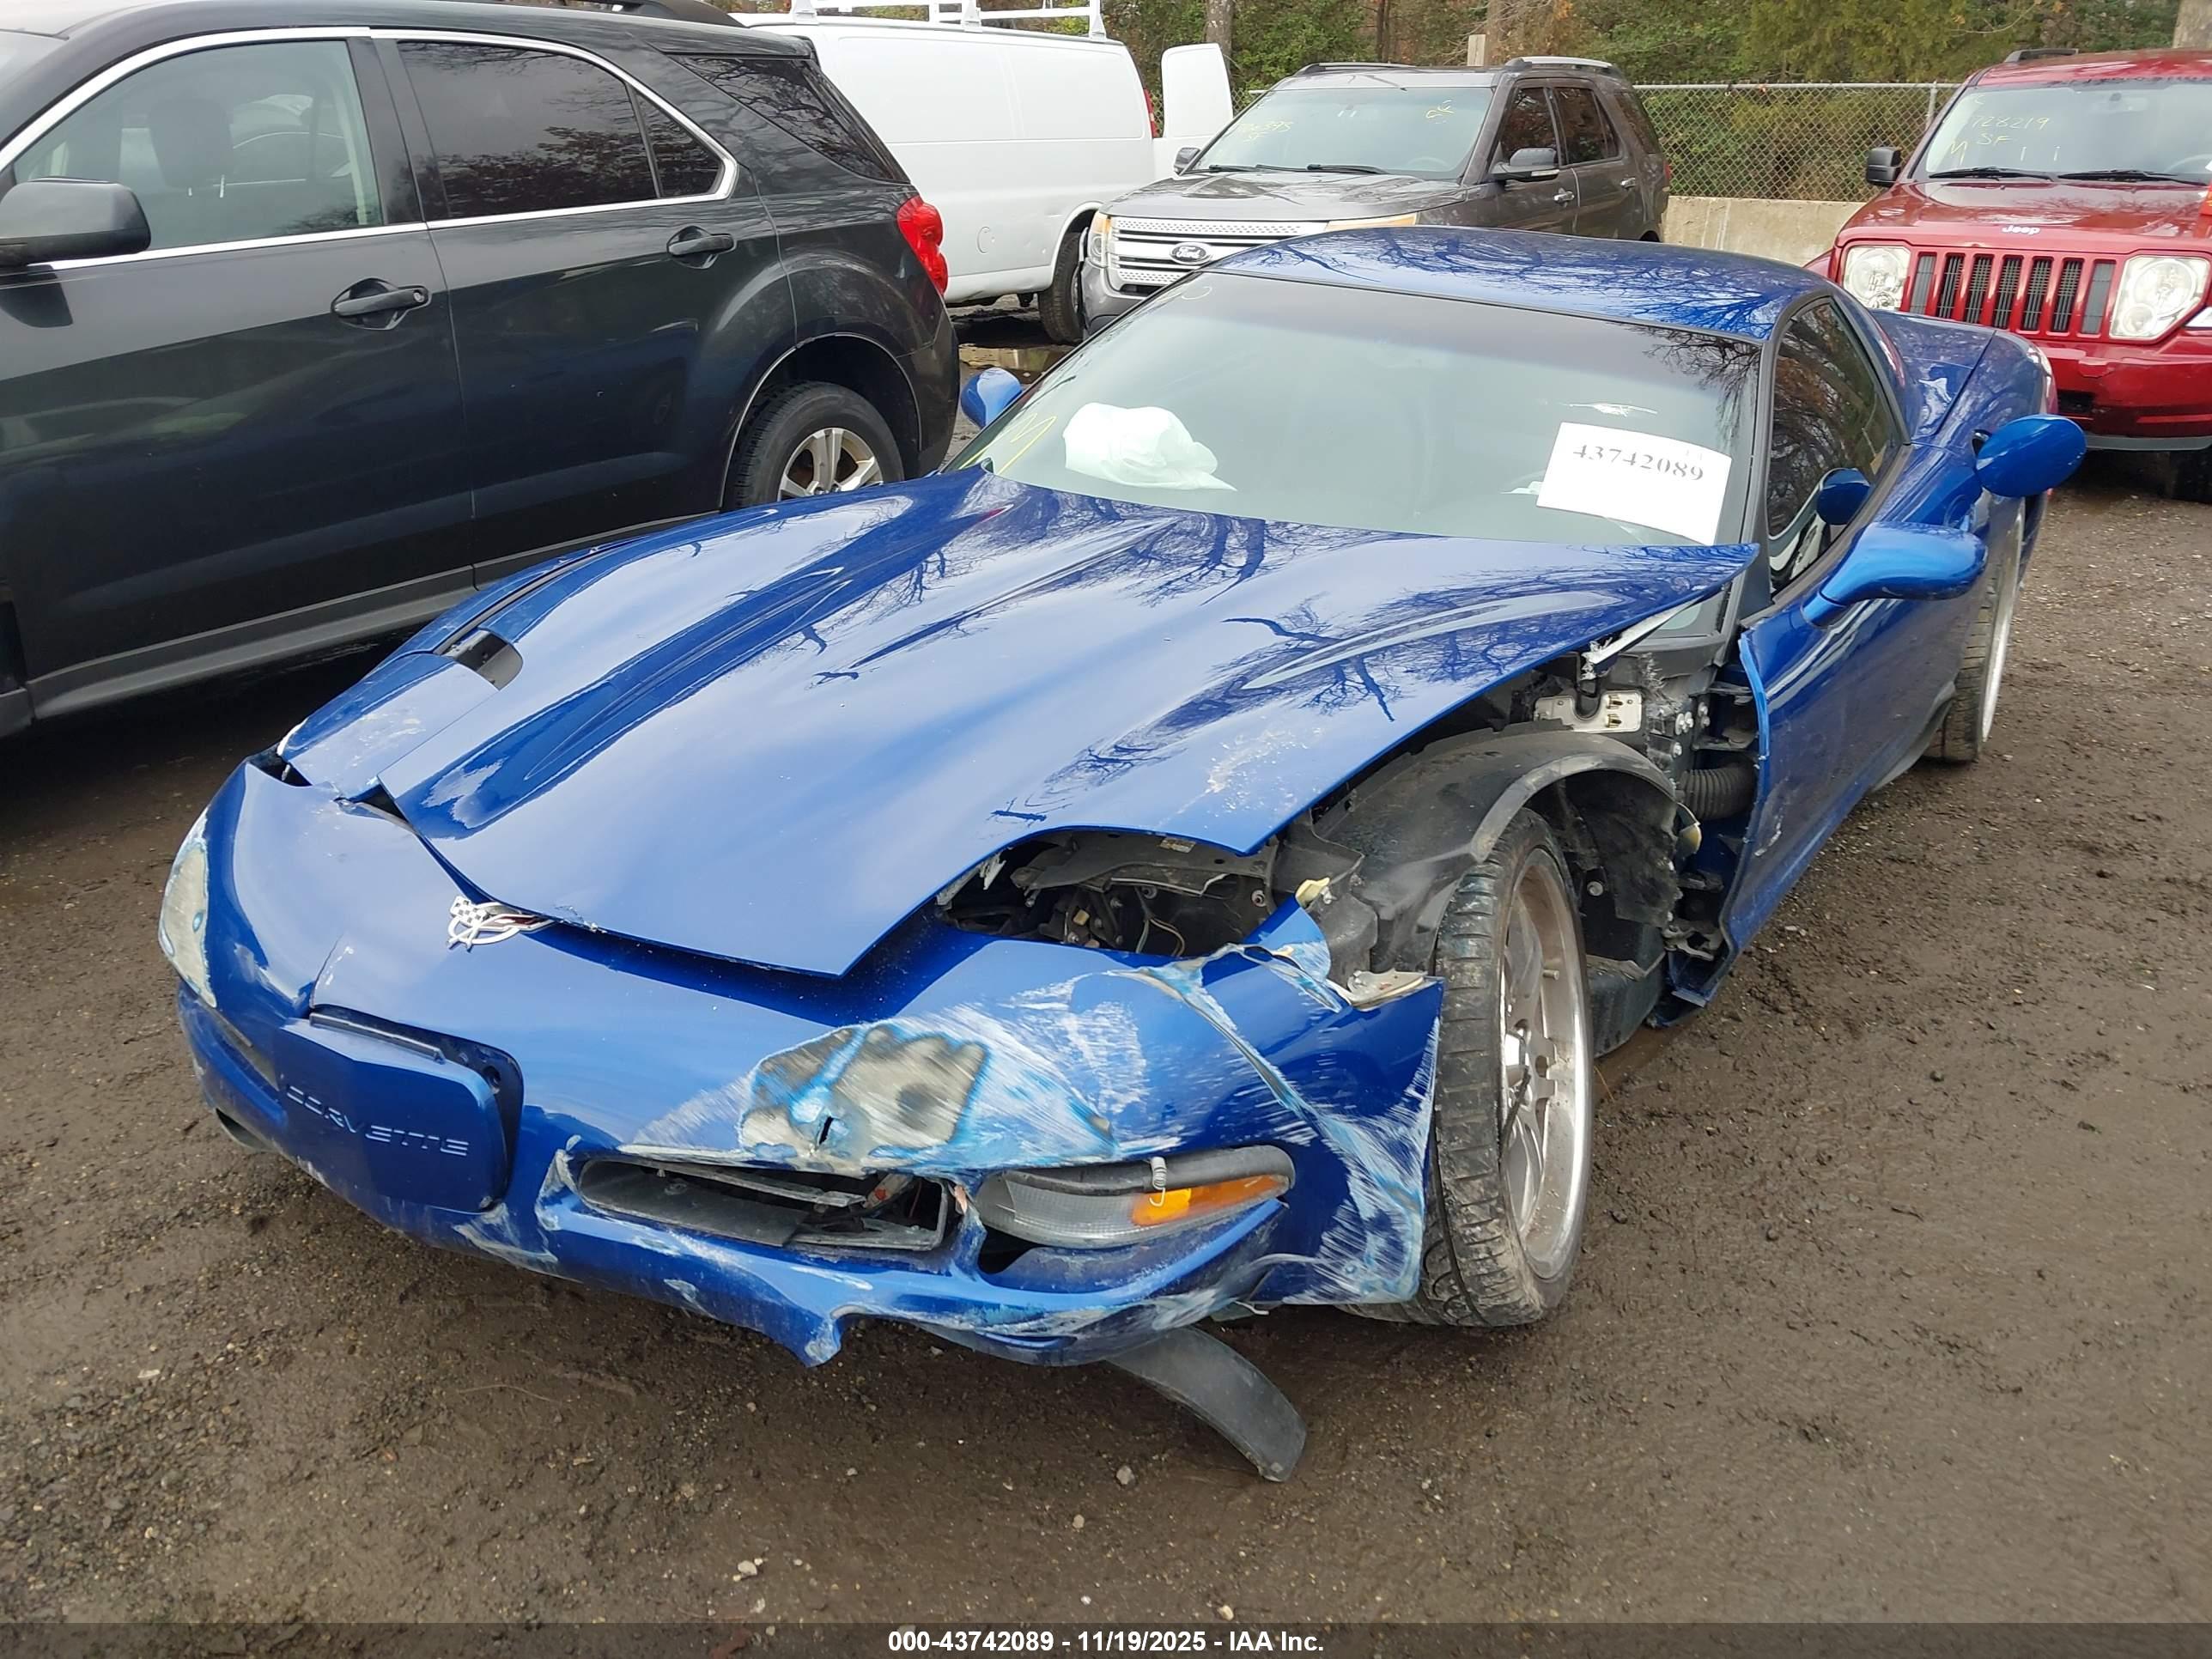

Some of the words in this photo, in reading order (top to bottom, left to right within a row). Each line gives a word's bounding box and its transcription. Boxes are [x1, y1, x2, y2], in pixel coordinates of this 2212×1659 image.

[2002, 225, 2041, 235] Jeep
[1572, 444, 1704, 480] 43742089
[286, 1085, 470, 1157] CORVETTE
